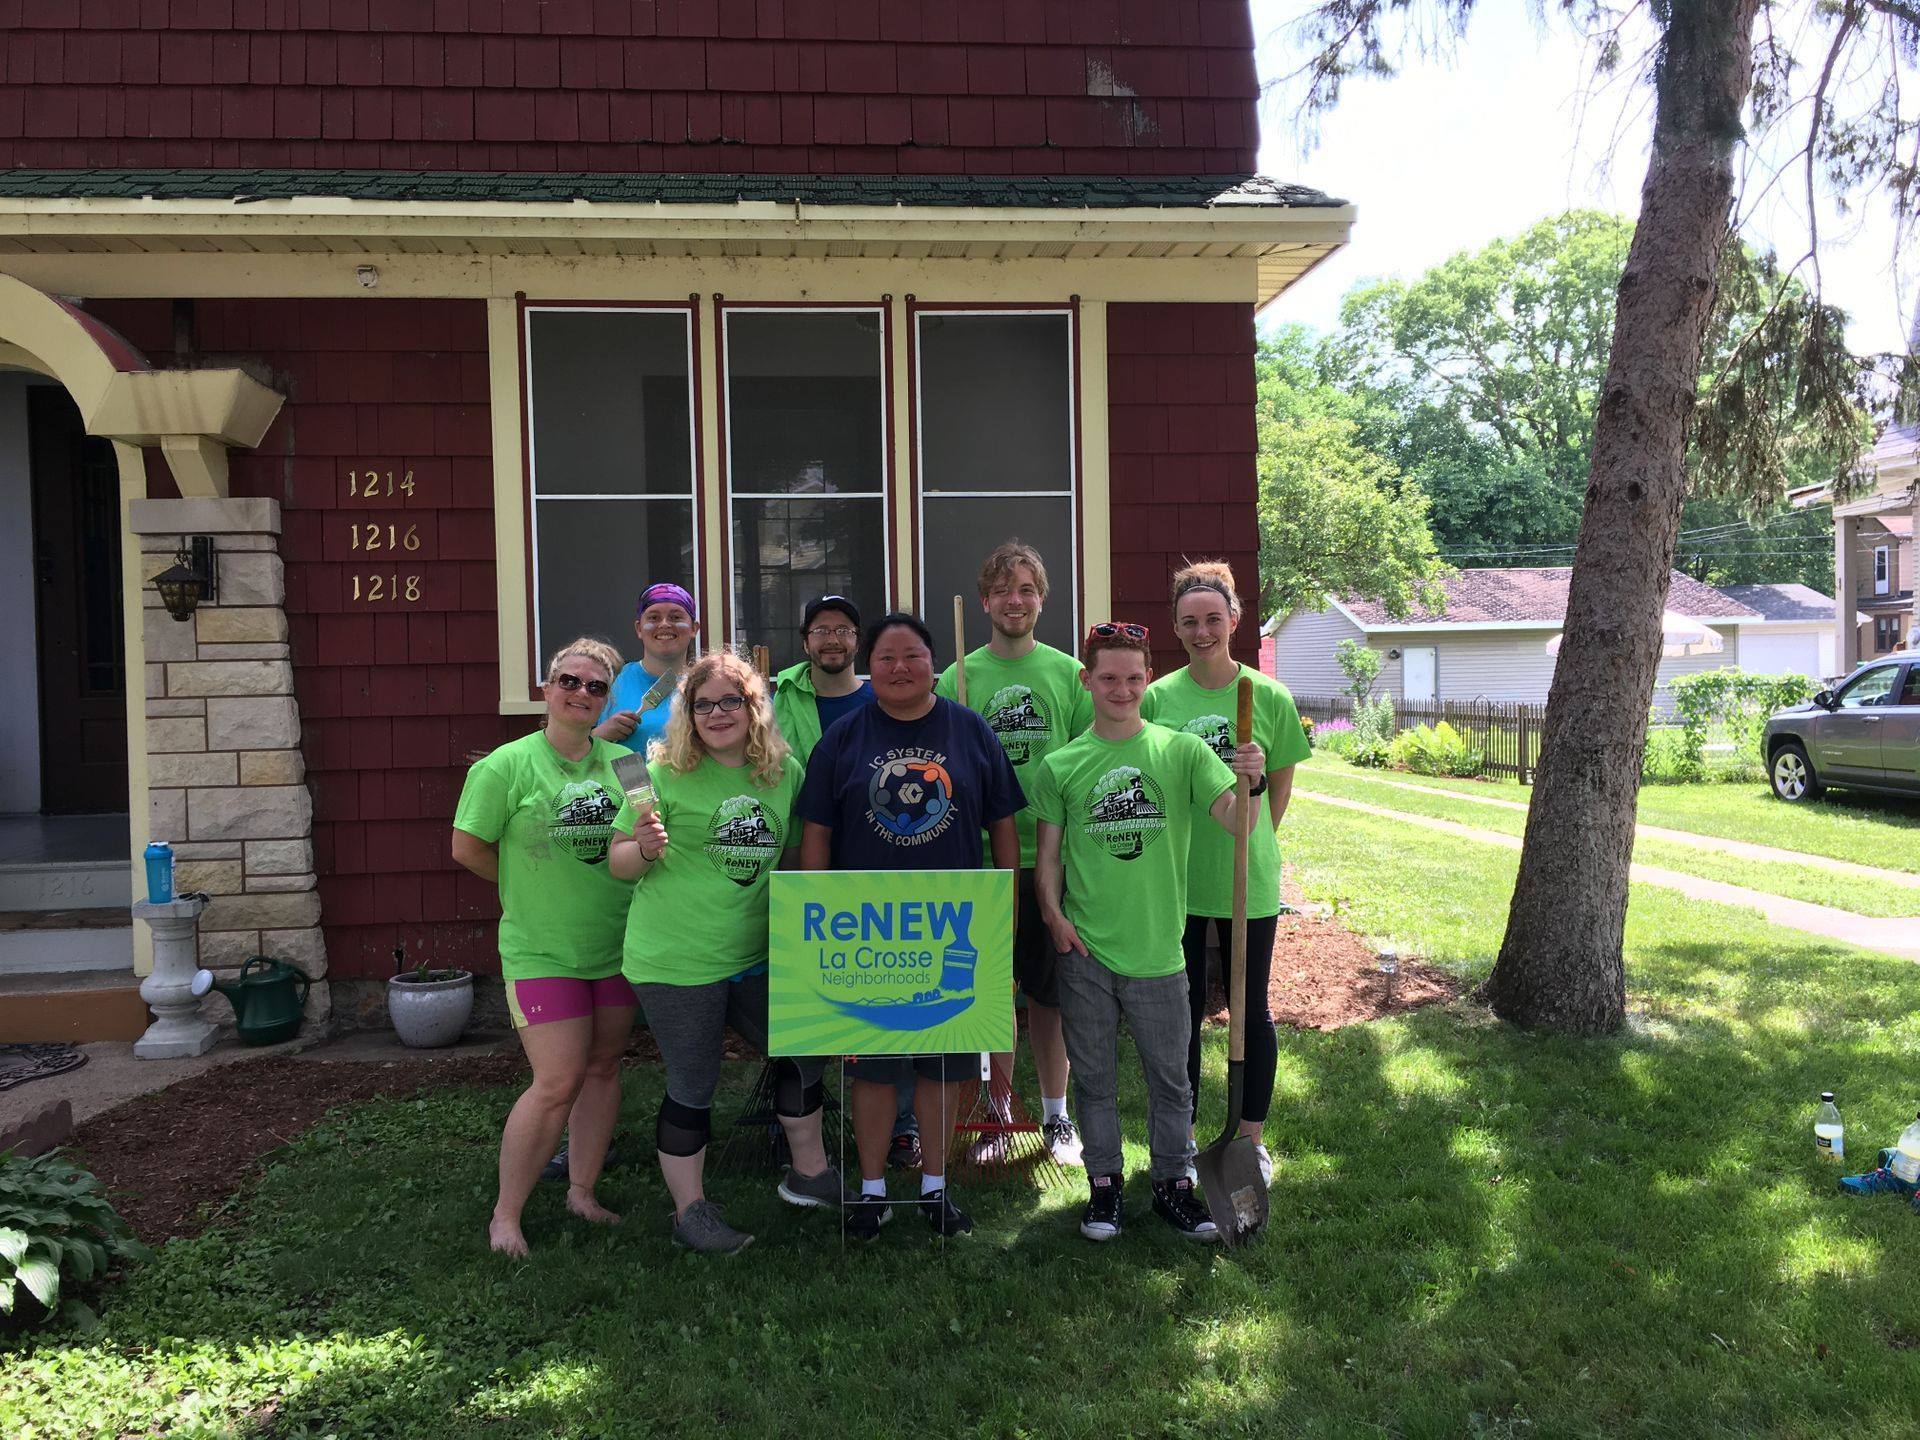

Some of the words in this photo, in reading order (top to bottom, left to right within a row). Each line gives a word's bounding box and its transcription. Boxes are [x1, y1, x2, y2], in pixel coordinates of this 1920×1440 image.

[349, 470, 415, 498] 1214
[351, 523, 421, 551] 1216
[352, 574, 421, 602] 1218
[868, 755, 884, 770] IC
[886, 747, 947, 765] SYSTEM
[864, 809, 876, 824] IN
[874, 821, 895, 843] THE
[895, 803, 959, 847] COMMUNITY
[1106, 832, 1141, 842] ReNEW
[572, 837, 608, 847] ReNEW
[725, 858, 760, 869] ReNEW
[803, 901, 973, 941] ReNEW
[819, 948, 846, 970] La
[855, 946, 933, 970] Crosse
[822, 970, 931, 988] Neighborhoods
